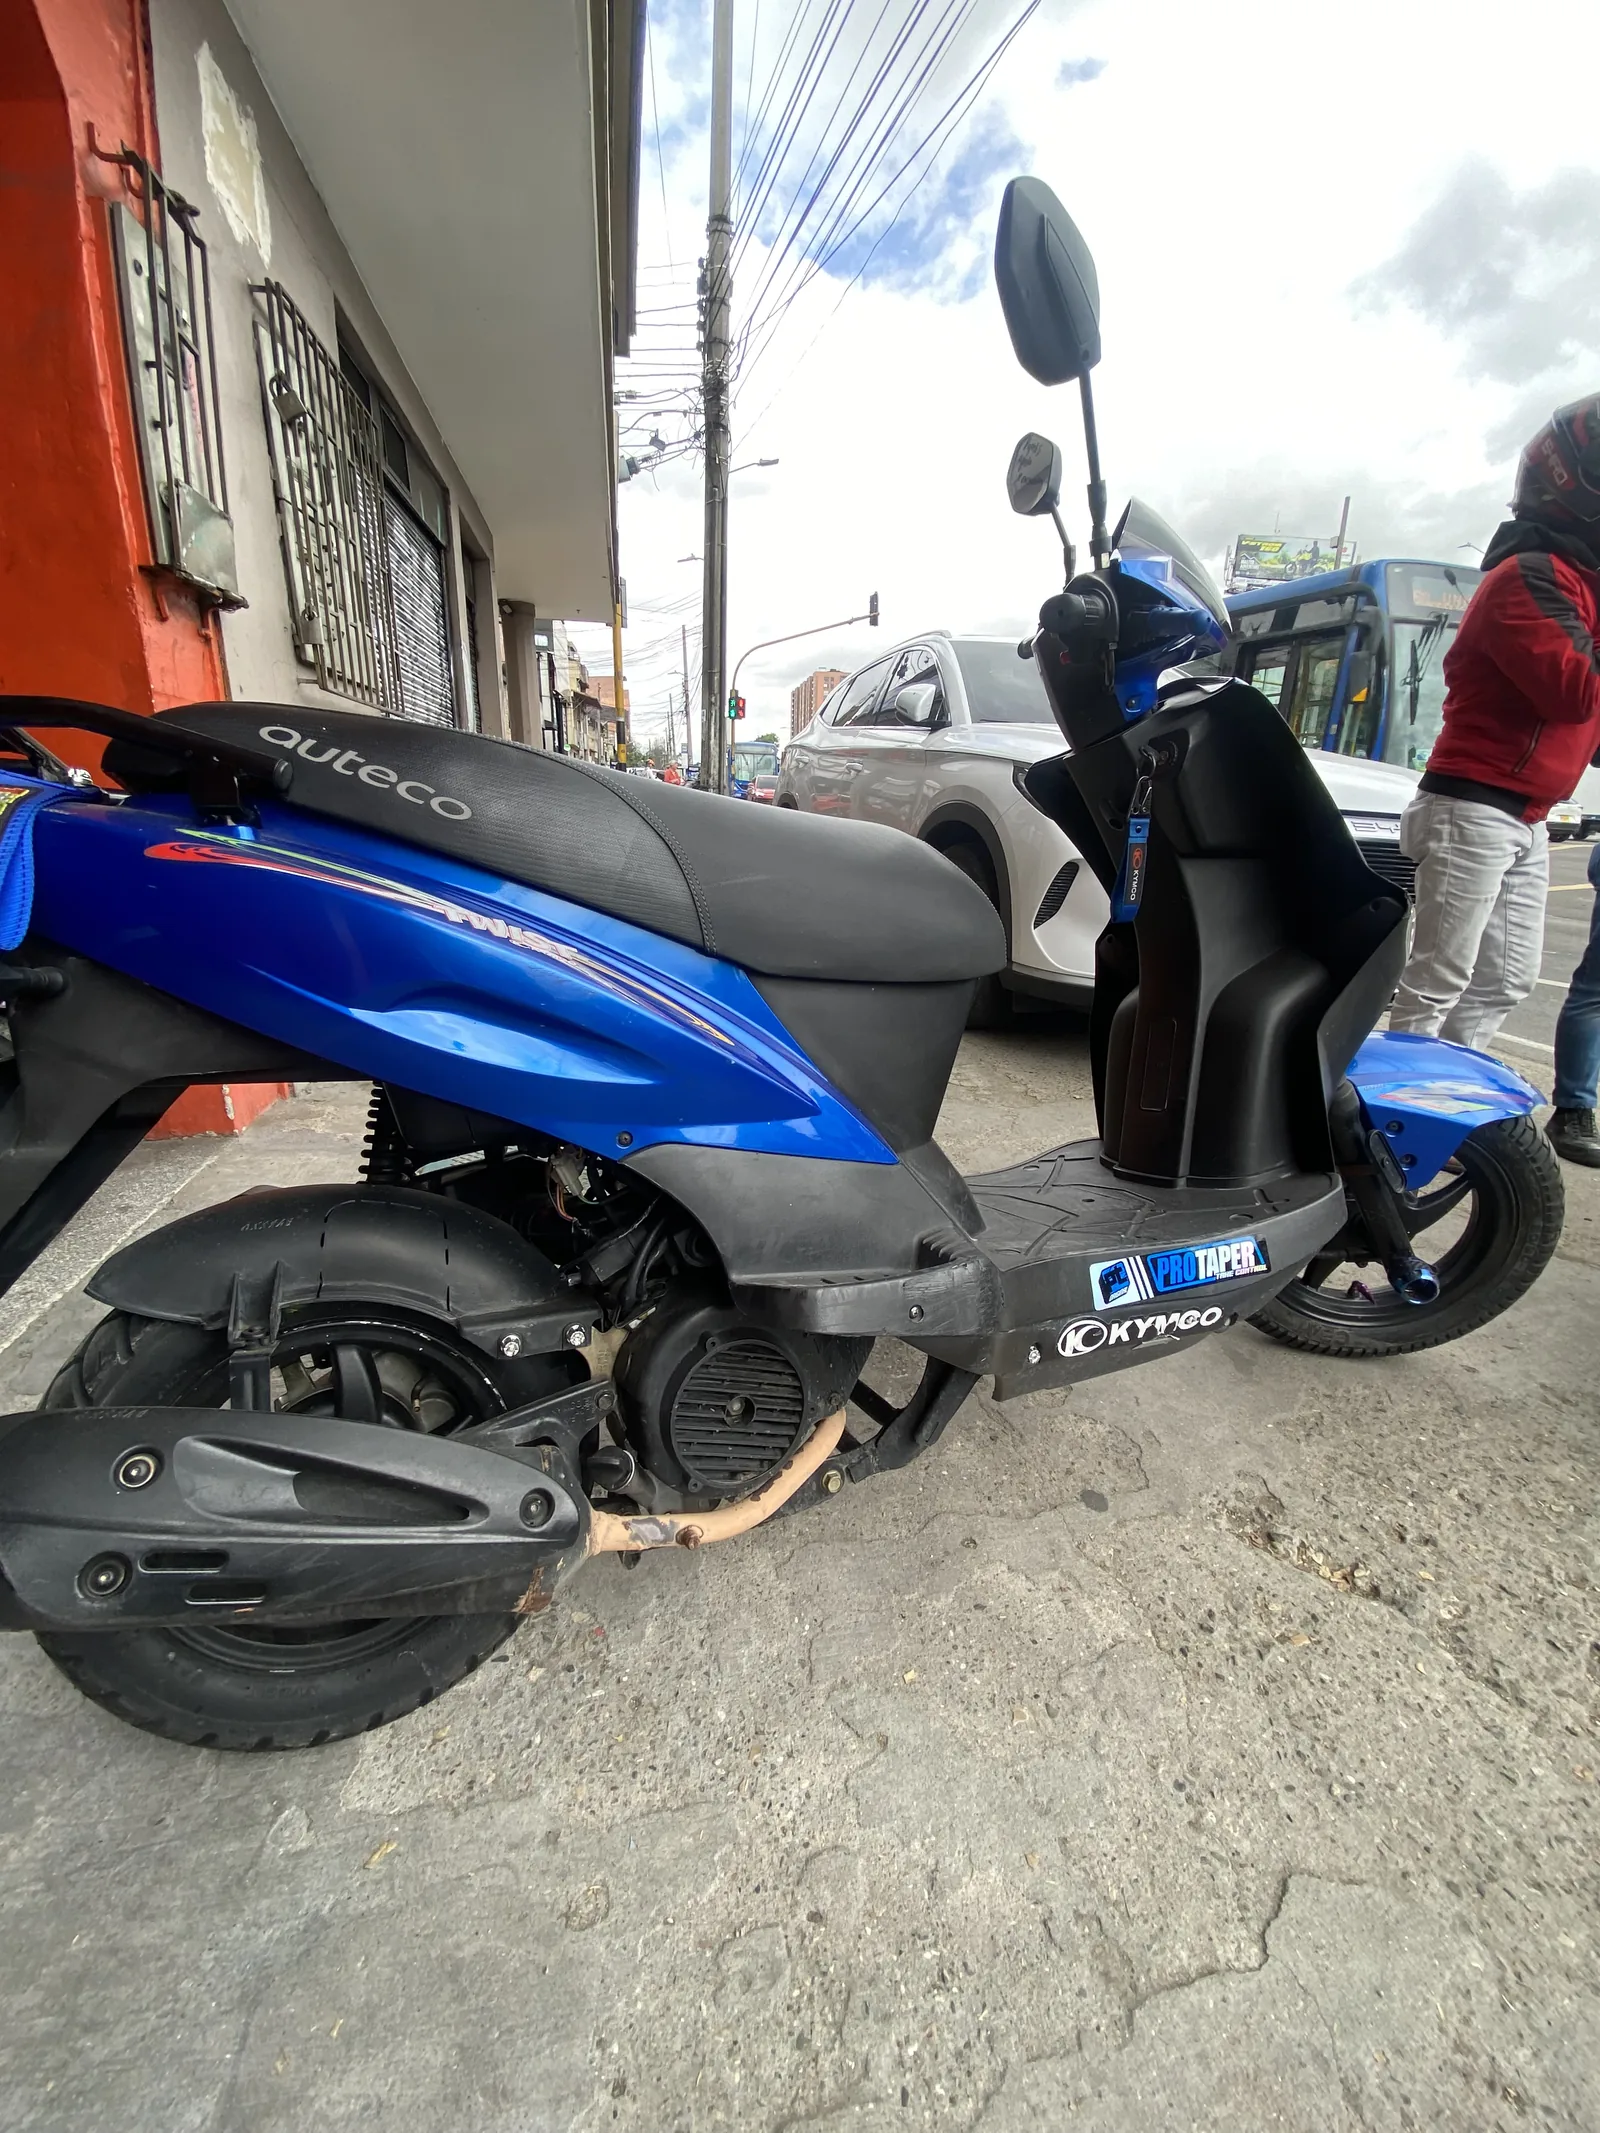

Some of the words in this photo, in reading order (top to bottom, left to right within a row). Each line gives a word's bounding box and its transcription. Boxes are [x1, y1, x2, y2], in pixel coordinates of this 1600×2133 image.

[258, 726, 473, 820] auteco
[1130, 869, 1140, 901] KYMCO
[436, 905, 578, 962] TWIST
[1235, 1264, 1268, 1276] CONTROL
[1109, 1306, 1223, 1345] KYMCO
